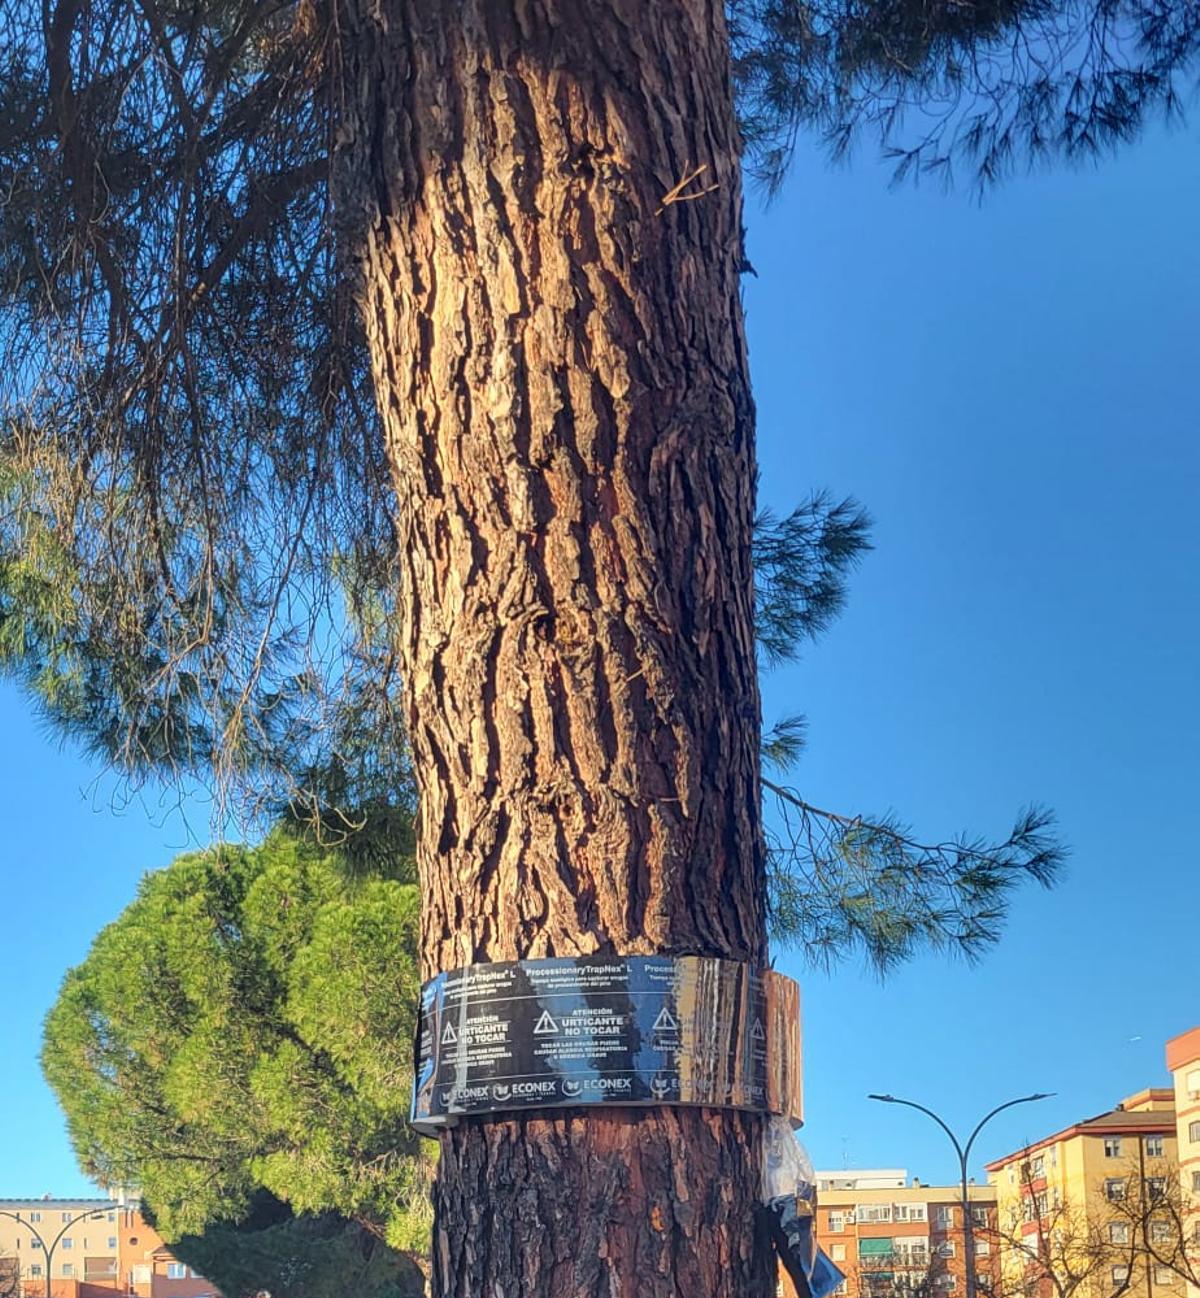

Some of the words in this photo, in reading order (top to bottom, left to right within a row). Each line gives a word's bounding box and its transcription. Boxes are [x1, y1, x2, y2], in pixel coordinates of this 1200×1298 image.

[572, 1008, 613, 1016] ATENCIÓN
[562, 1017, 623, 1027] URTICANTE
[459, 1023, 508, 1036] URTICANTE
[565, 1027, 580, 1036] NO
[583, 1026, 620, 1035] TOCAR
[475, 1033, 506, 1043] TOCAR
[512, 1081, 556, 1094] ECONEX
[583, 1078, 632, 1089] ECONEX
